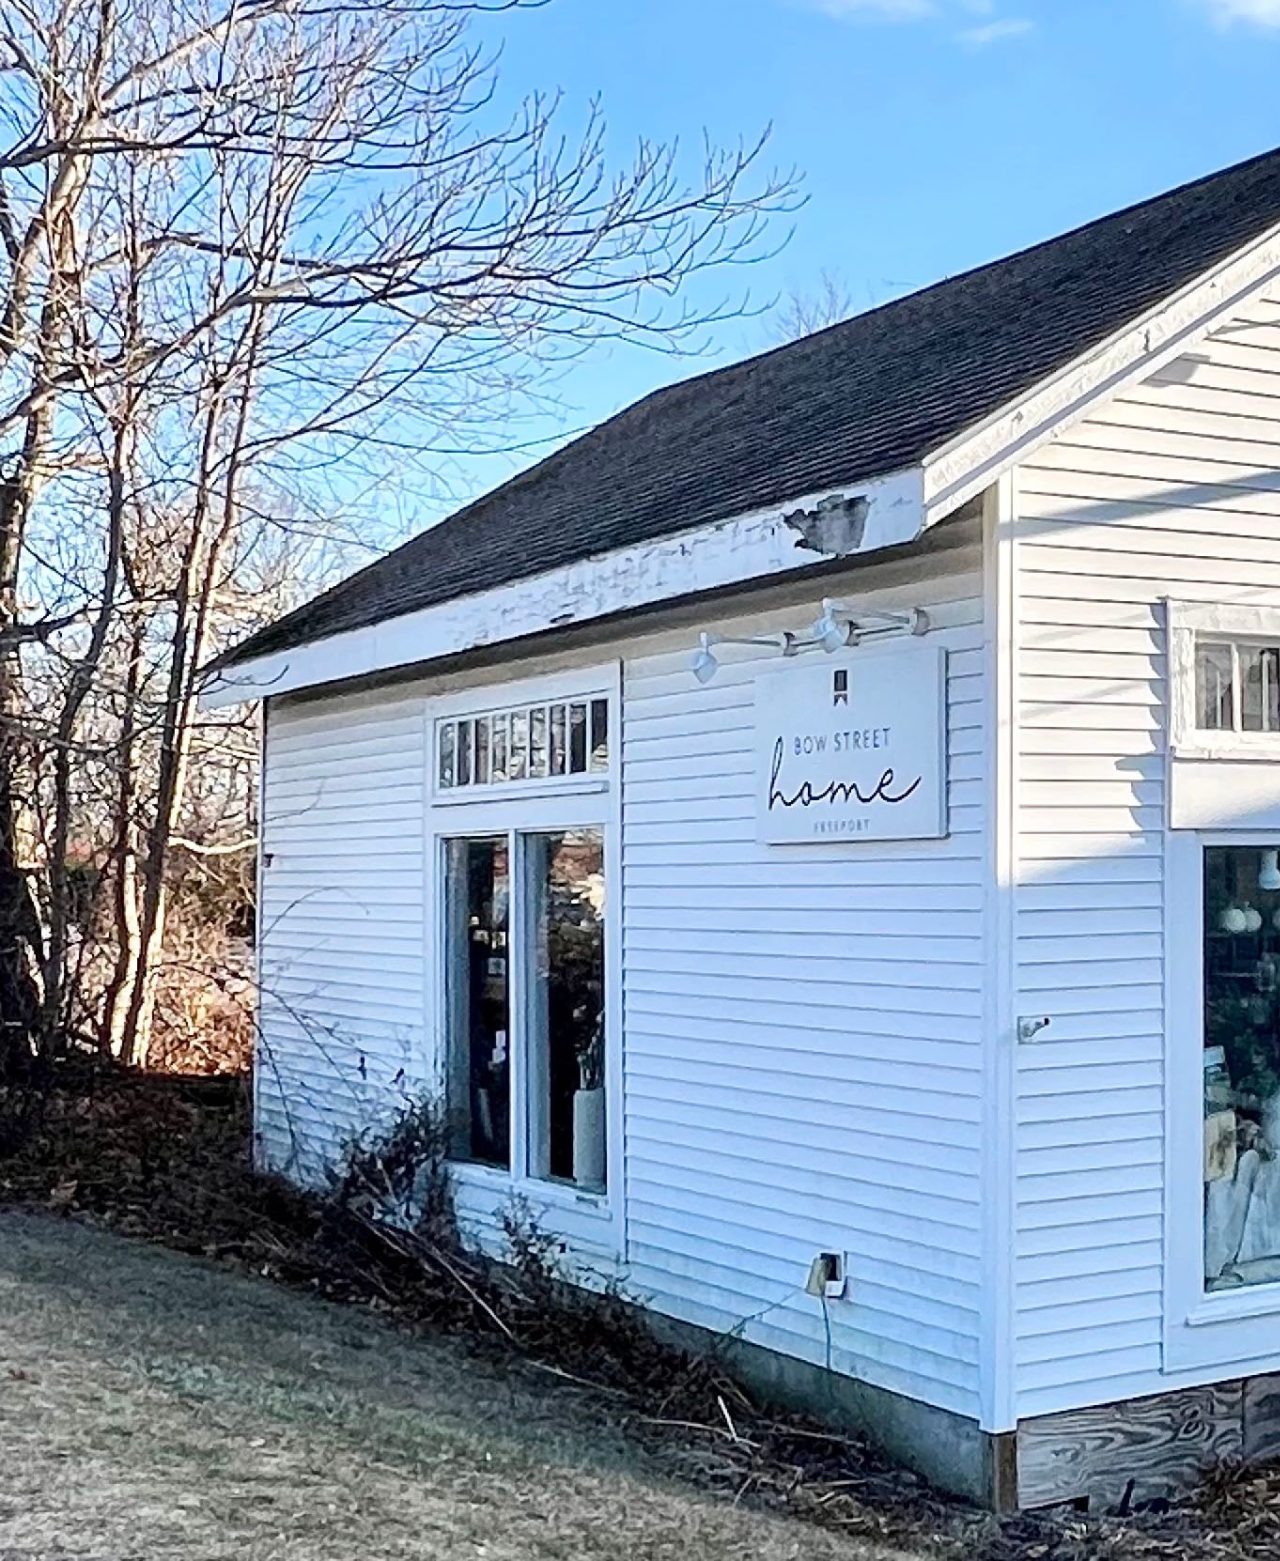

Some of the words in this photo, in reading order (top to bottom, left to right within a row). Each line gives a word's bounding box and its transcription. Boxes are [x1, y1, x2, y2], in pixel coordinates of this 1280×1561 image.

[794, 736, 828, 755] BOW
[834, 727, 891, 751] STREET
[768, 736, 922, 811] home
[813, 818, 871, 833] FREEPORT
